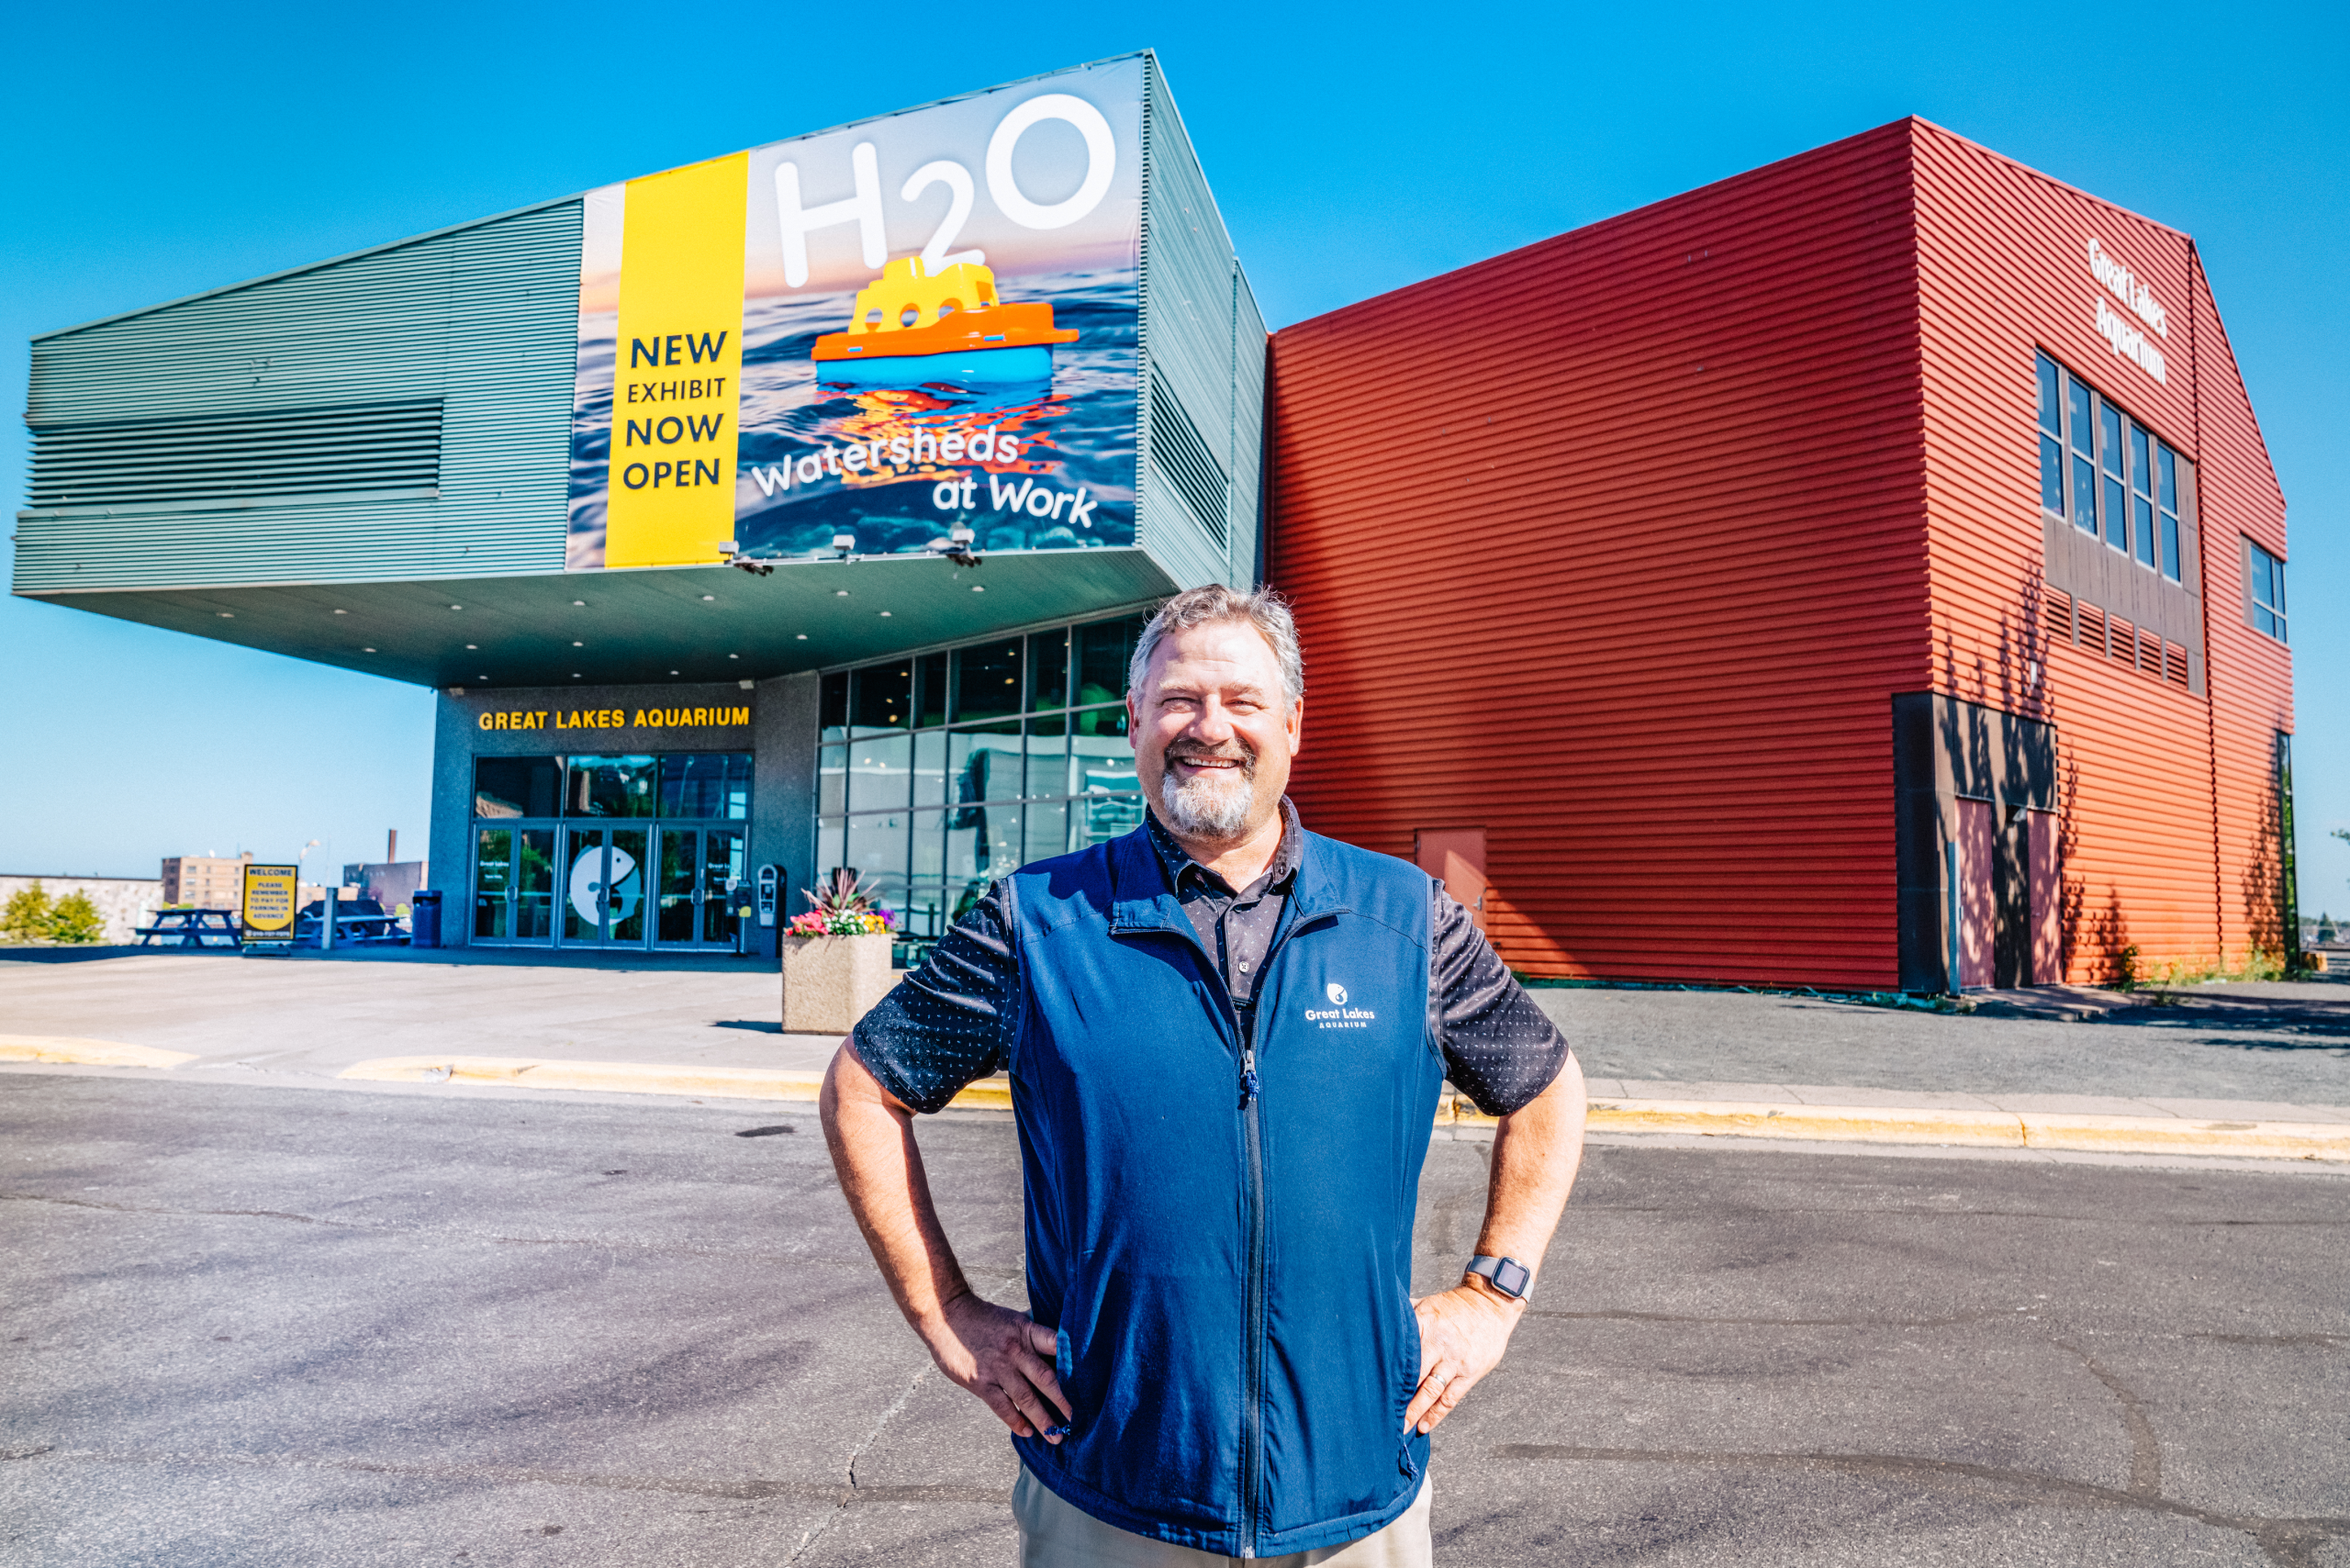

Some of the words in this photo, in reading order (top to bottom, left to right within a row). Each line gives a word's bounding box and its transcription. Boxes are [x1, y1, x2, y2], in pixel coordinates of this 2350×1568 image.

[775, 94, 1115, 288] H2O
[2087, 238, 2129, 305] Great
[2128, 273, 2167, 339] Lakes
[631, 330, 728, 369] NEW
[2096, 296, 2166, 386] Aquarium
[627, 377, 726, 404] EXHIBIT
[626, 413, 724, 447] NOW
[622, 458, 720, 490] OPEN
[750, 424, 1020, 497] Watersheds
[932, 476, 979, 510] at
[989, 474, 1099, 529] Work
[478, 711, 548, 731] GREAT
[555, 709, 625, 729] LAKES
[633, 706, 750, 728] AQUARIUM
[249, 868, 293, 877] WELCOME
[1304, 1009, 1340, 1021] Great
[1342, 1007, 1375, 1019] Lakes
